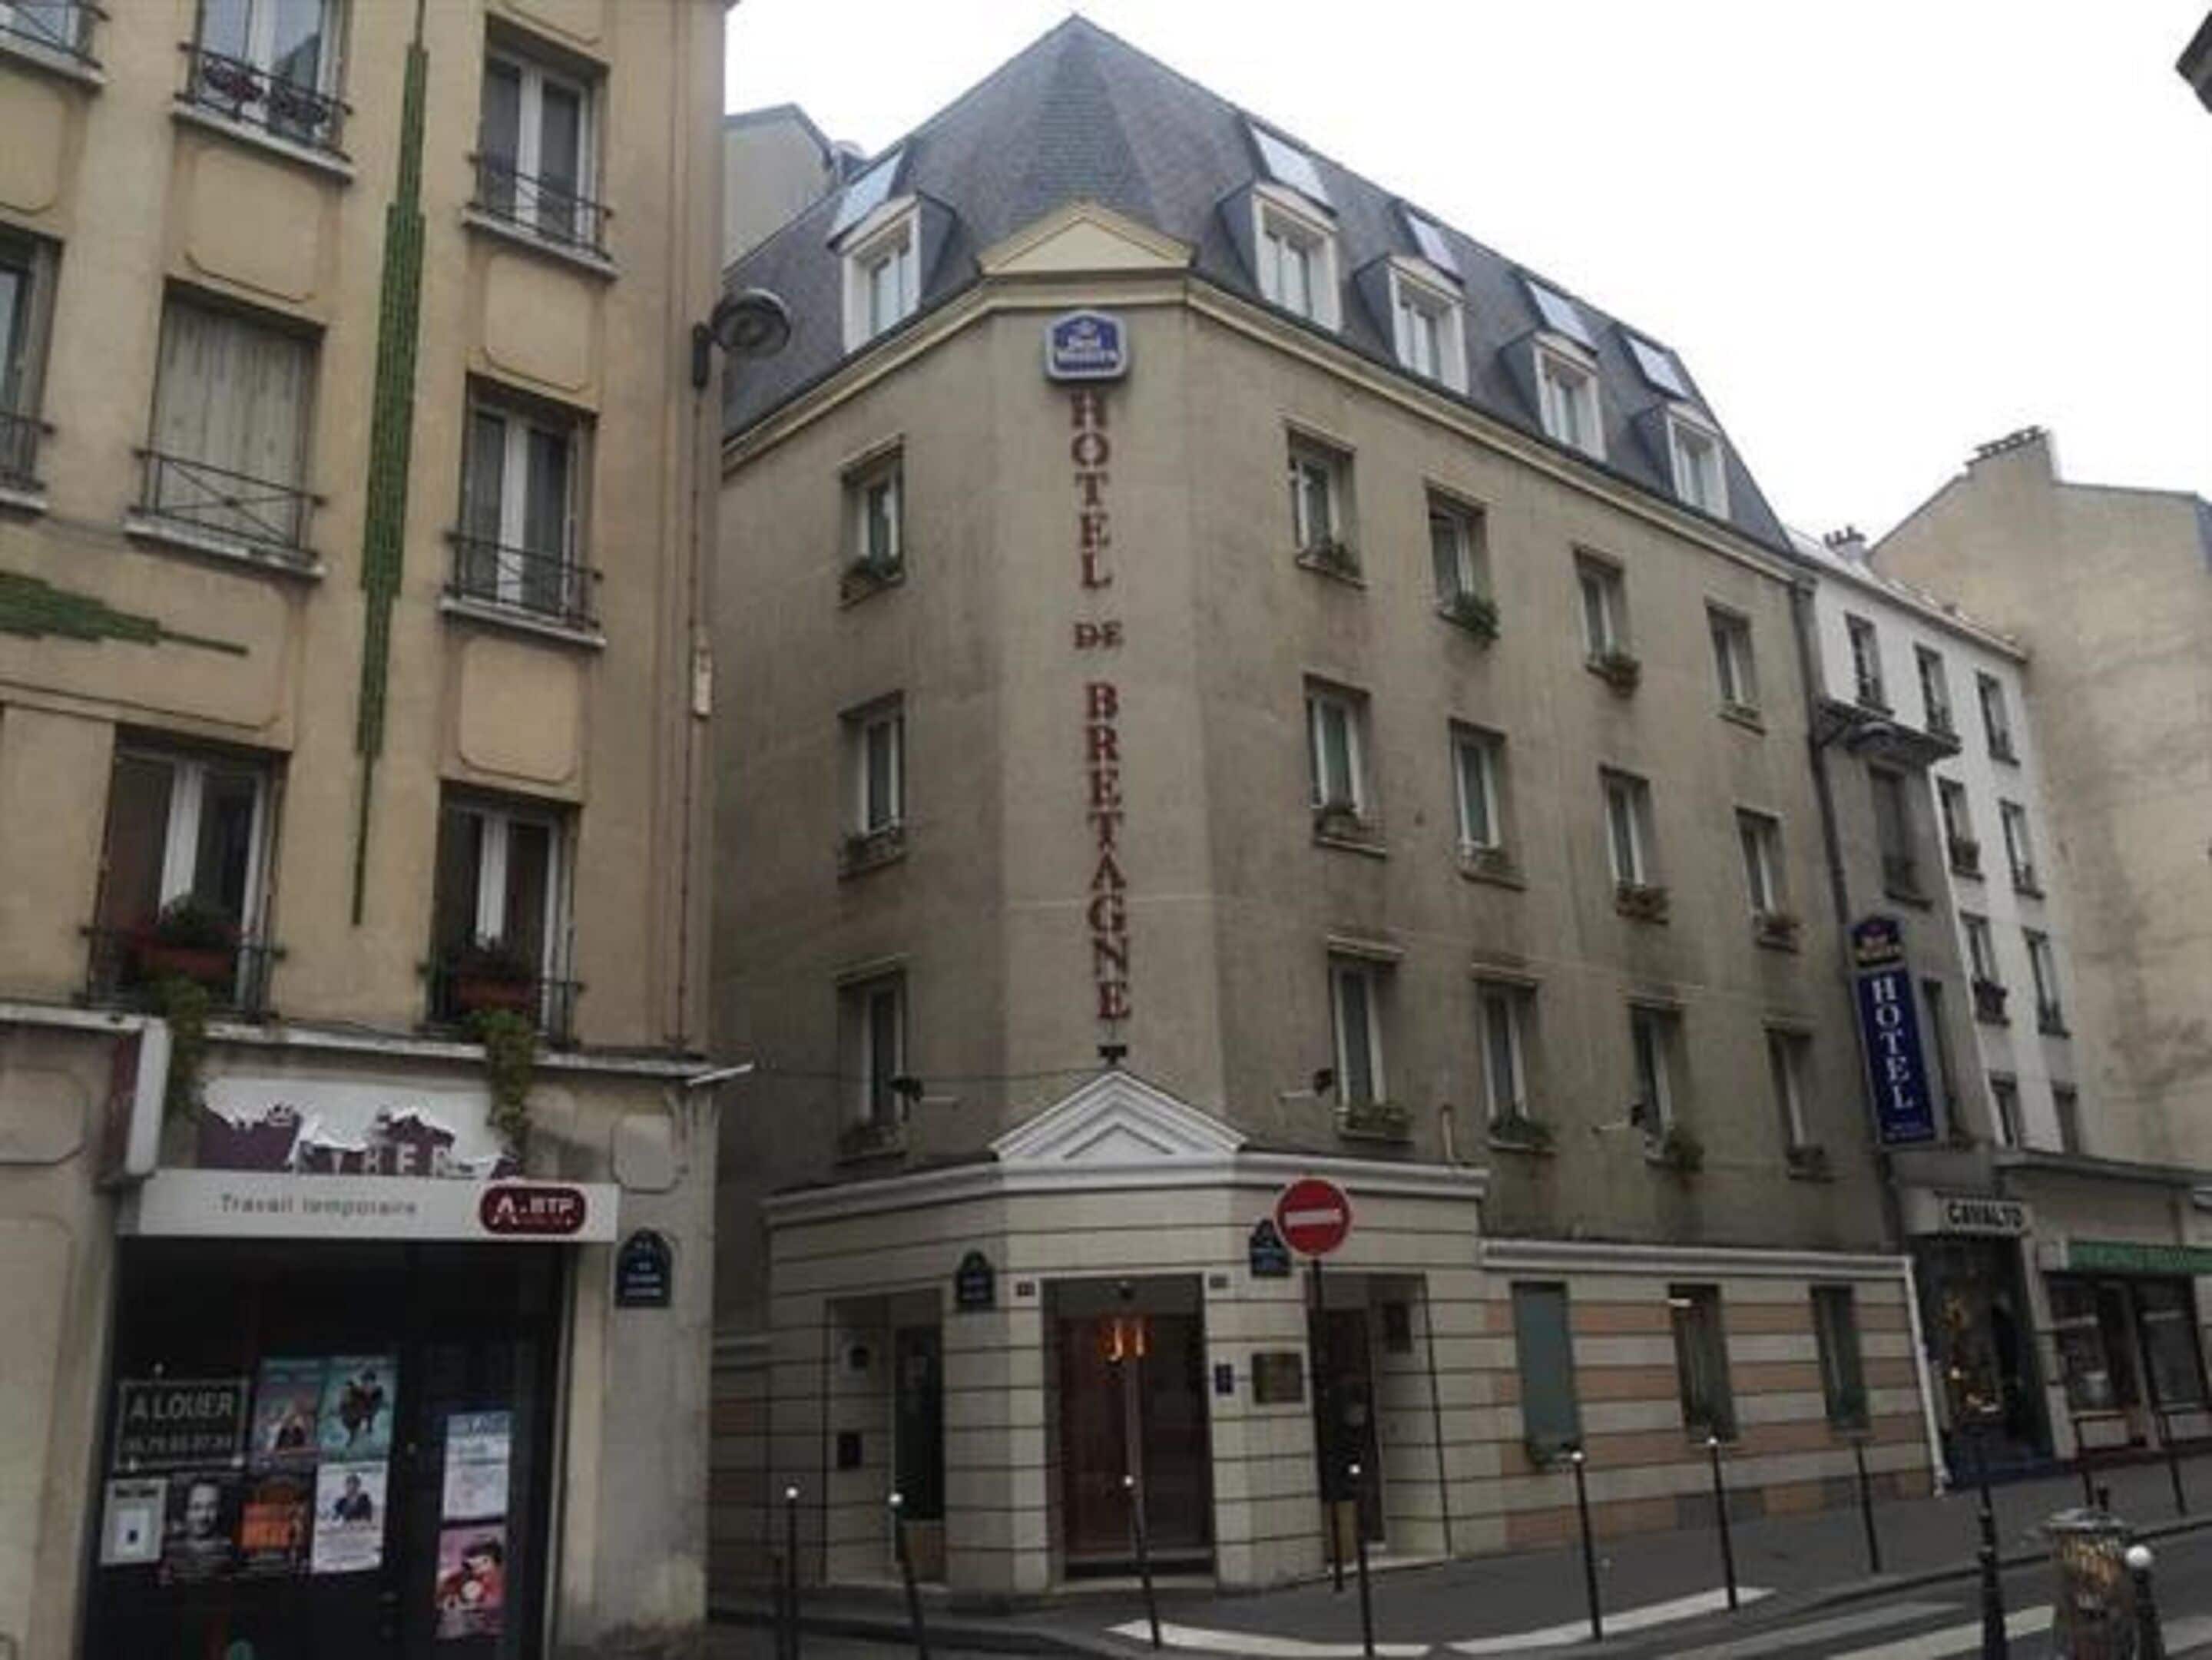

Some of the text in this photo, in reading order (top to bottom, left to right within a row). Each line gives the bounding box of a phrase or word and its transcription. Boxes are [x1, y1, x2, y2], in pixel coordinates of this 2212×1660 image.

[1071, 388, 1114, 591] HOTEL
[1075, 620, 1124, 651] DE
[1084, 681, 1132, 1022] BRETAGNE
[1871, 976, 1914, 1109] HOTEL
[154, 1391, 234, 1420] LOUER
